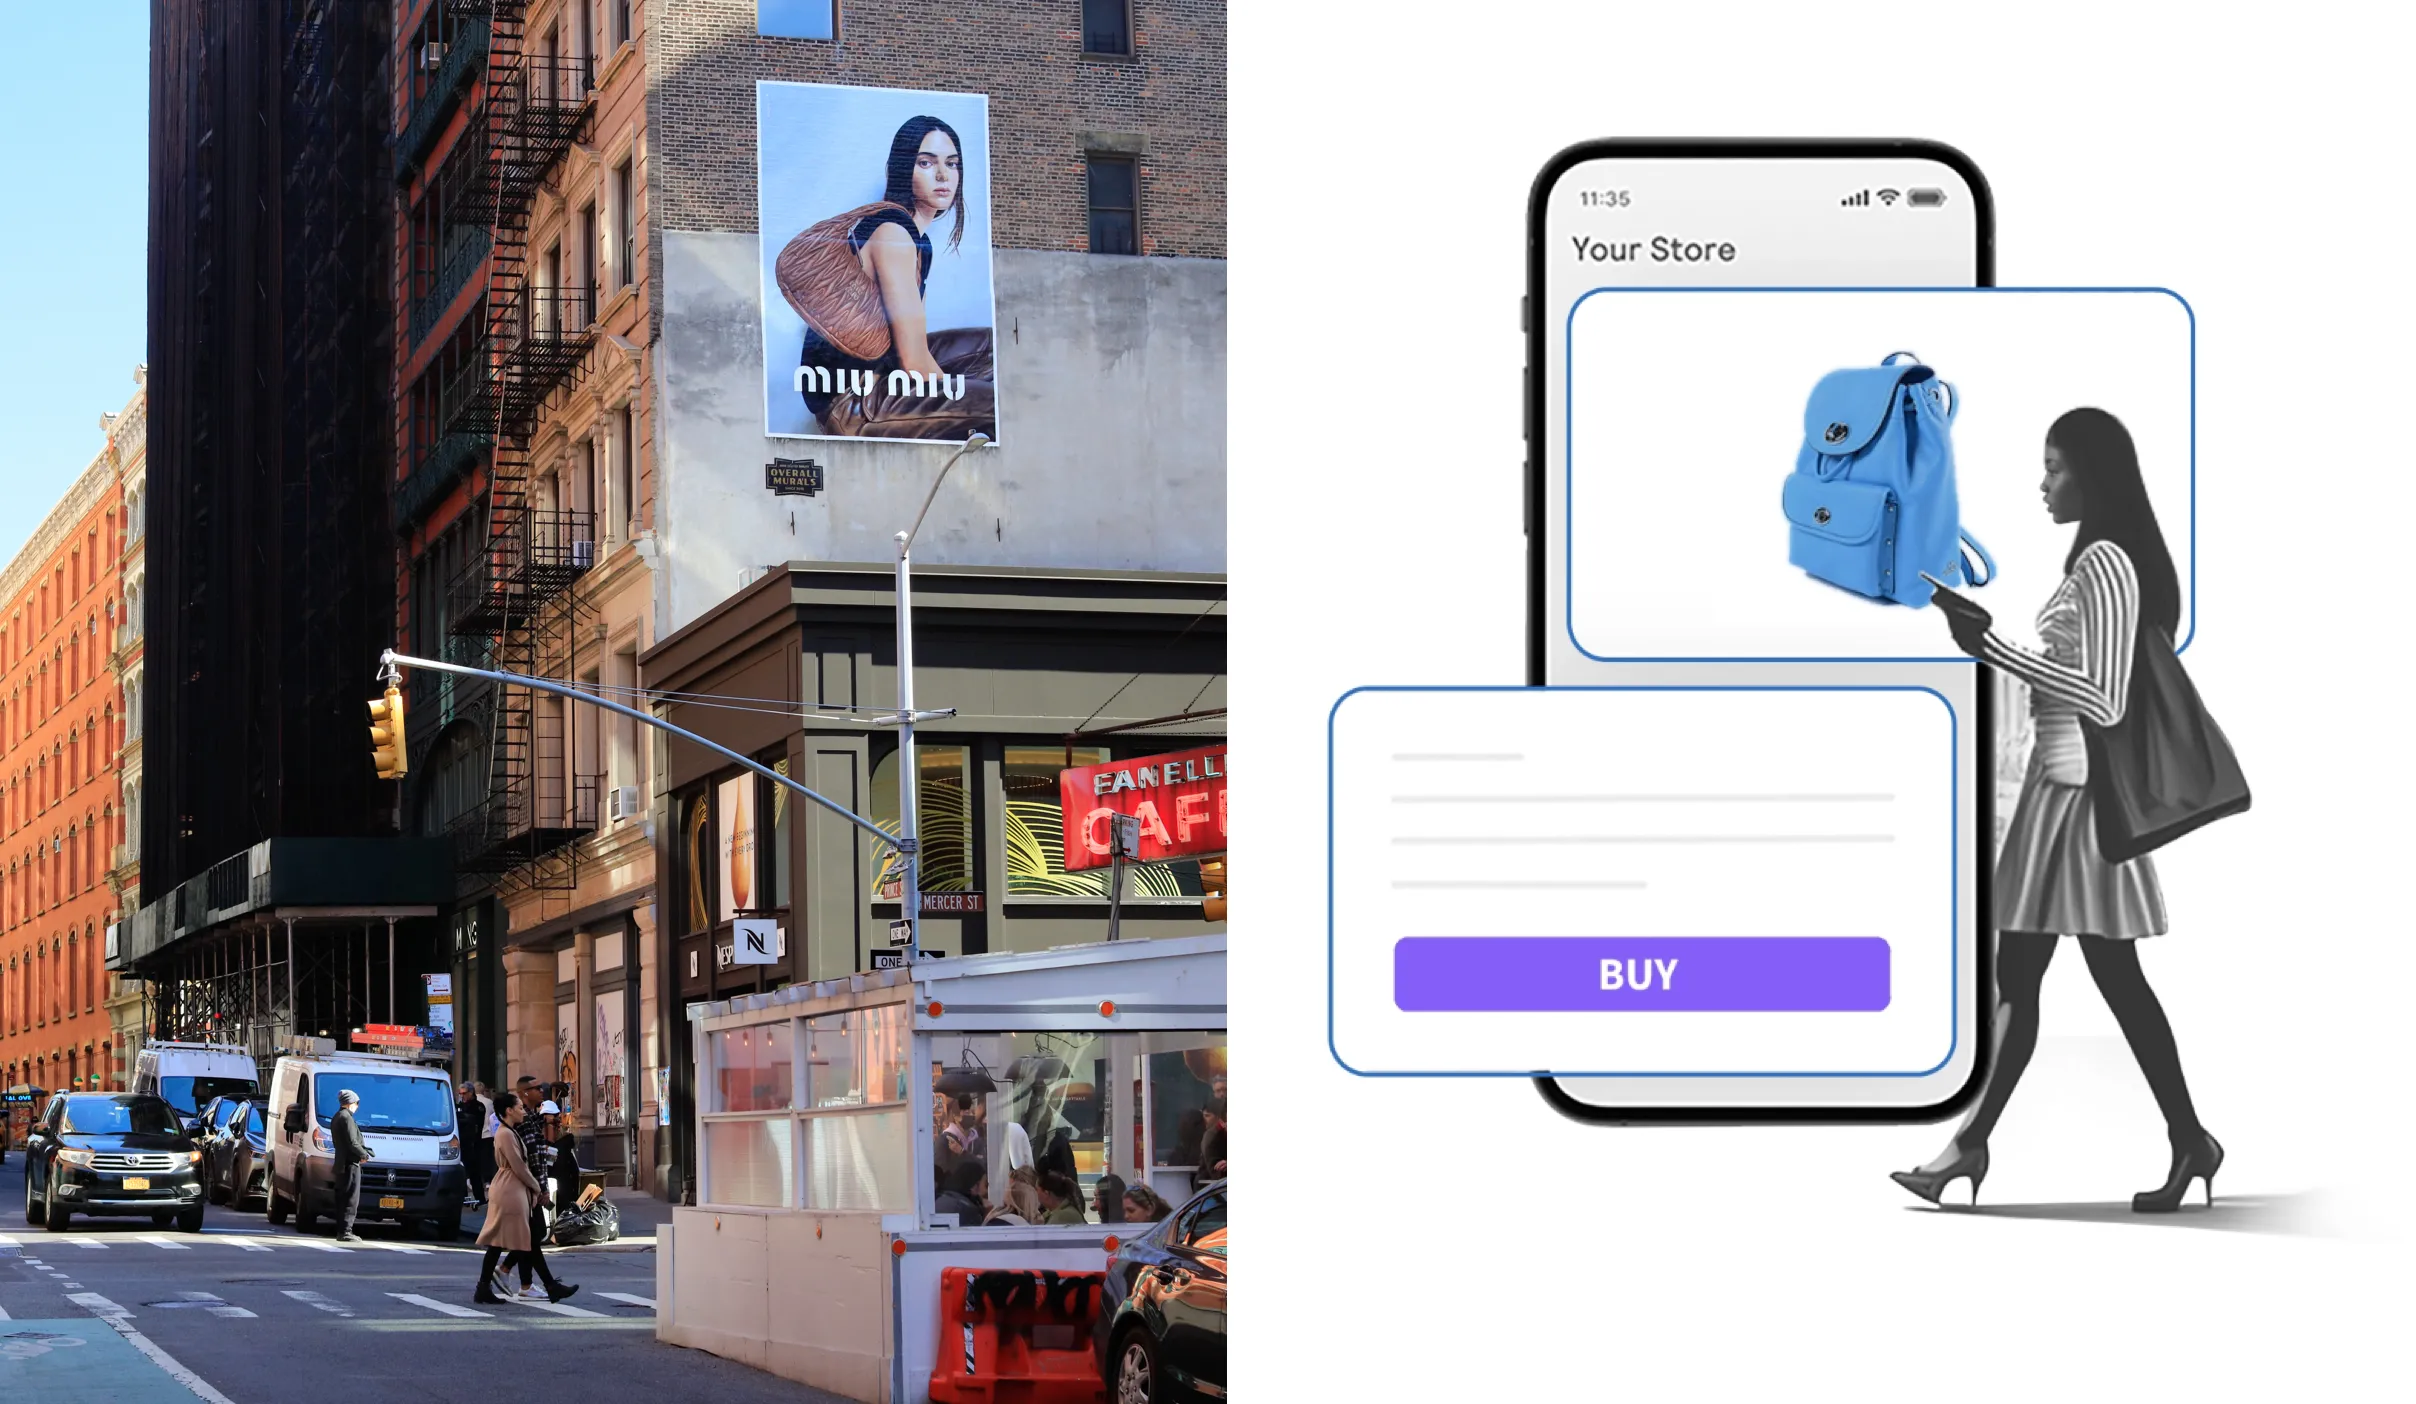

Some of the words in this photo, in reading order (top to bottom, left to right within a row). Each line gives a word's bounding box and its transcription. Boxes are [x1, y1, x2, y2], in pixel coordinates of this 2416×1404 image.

[1581, 190, 1631, 207] 11:35
[1572, 236, 1643, 262] Your
[1650, 235, 1736, 262] Store
[770, 468, 819, 478] OVERALL
[773, 476, 817, 486] MURALS
[1093, 754, 1227, 796] FANELL
[884, 882, 898, 899] PRINCE
[924, 894, 962, 911] MERCER
[967, 894, 979, 911] ST
[901, 927, 909, 938] WAY
[716, 944, 734, 970] NESP
[881, 957, 902, 968] ONE
[1600, 958, 1679, 991] BUY
